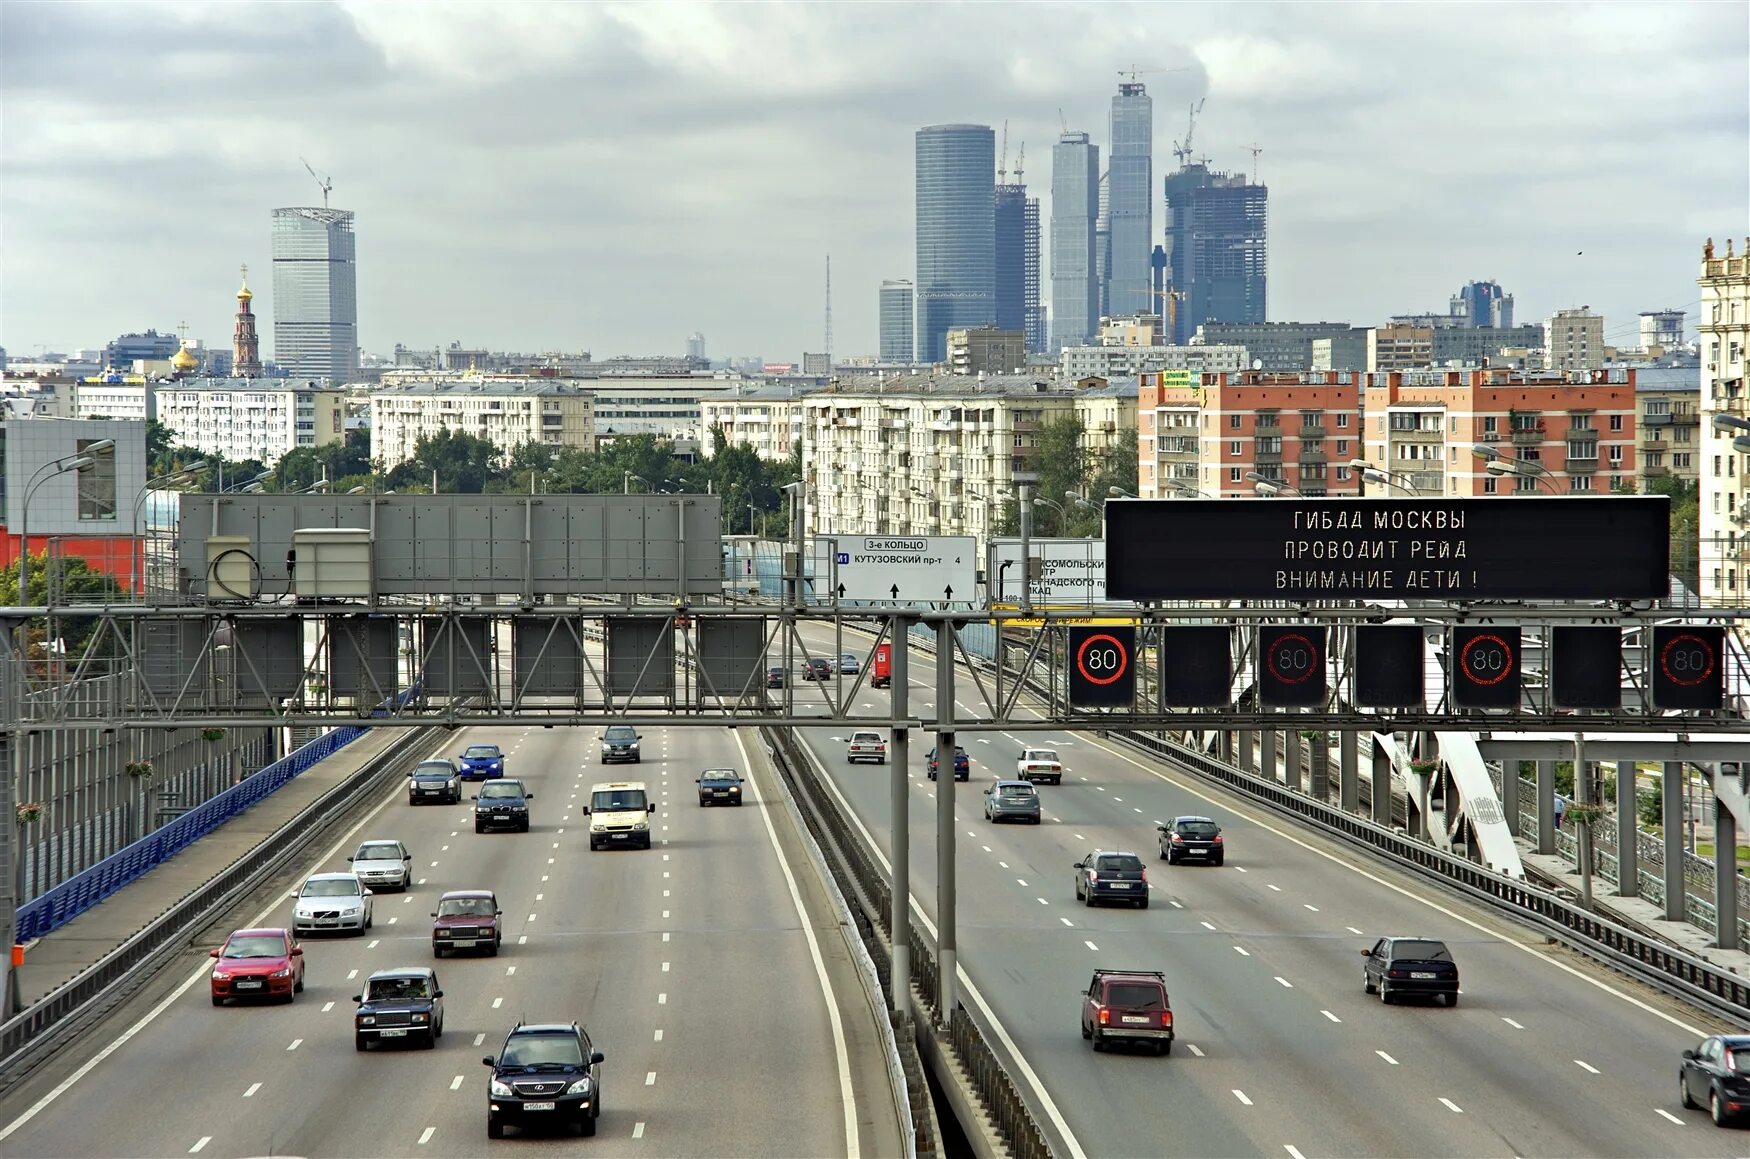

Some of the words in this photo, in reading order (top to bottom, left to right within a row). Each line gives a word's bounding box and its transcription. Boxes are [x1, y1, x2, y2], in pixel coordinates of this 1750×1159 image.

[1294, 511, 1362, 529] ГИБДД
[1374, 510, 1464, 529] МОСКВЫ
[868, 540, 883, 550] 3-е
[884, 540, 924, 552] КОЛЬЦО
[1285, 540, 1399, 559] ПРОВОДИТ
[1411, 540, 1466, 558] РЕЙД
[854, 553, 921, 564] КУТУЗОВСКИЙ
[923, 556, 942, 566] пр-т
[954, 556, 961, 565] 4
[1029, 578, 1095, 588] ЕРНАДСКОГО
[1276, 570, 1394, 589] ВНИМАНИЕ
[1406, 570, 1460, 588] ДЕТИ
[1472, 570, 1477, 589] !
[1089, 649, 1117, 670] 80
[1279, 649, 1307, 670] 80
[1473, 649, 1501, 670] 80
[1673, 649, 1704, 671] 80
